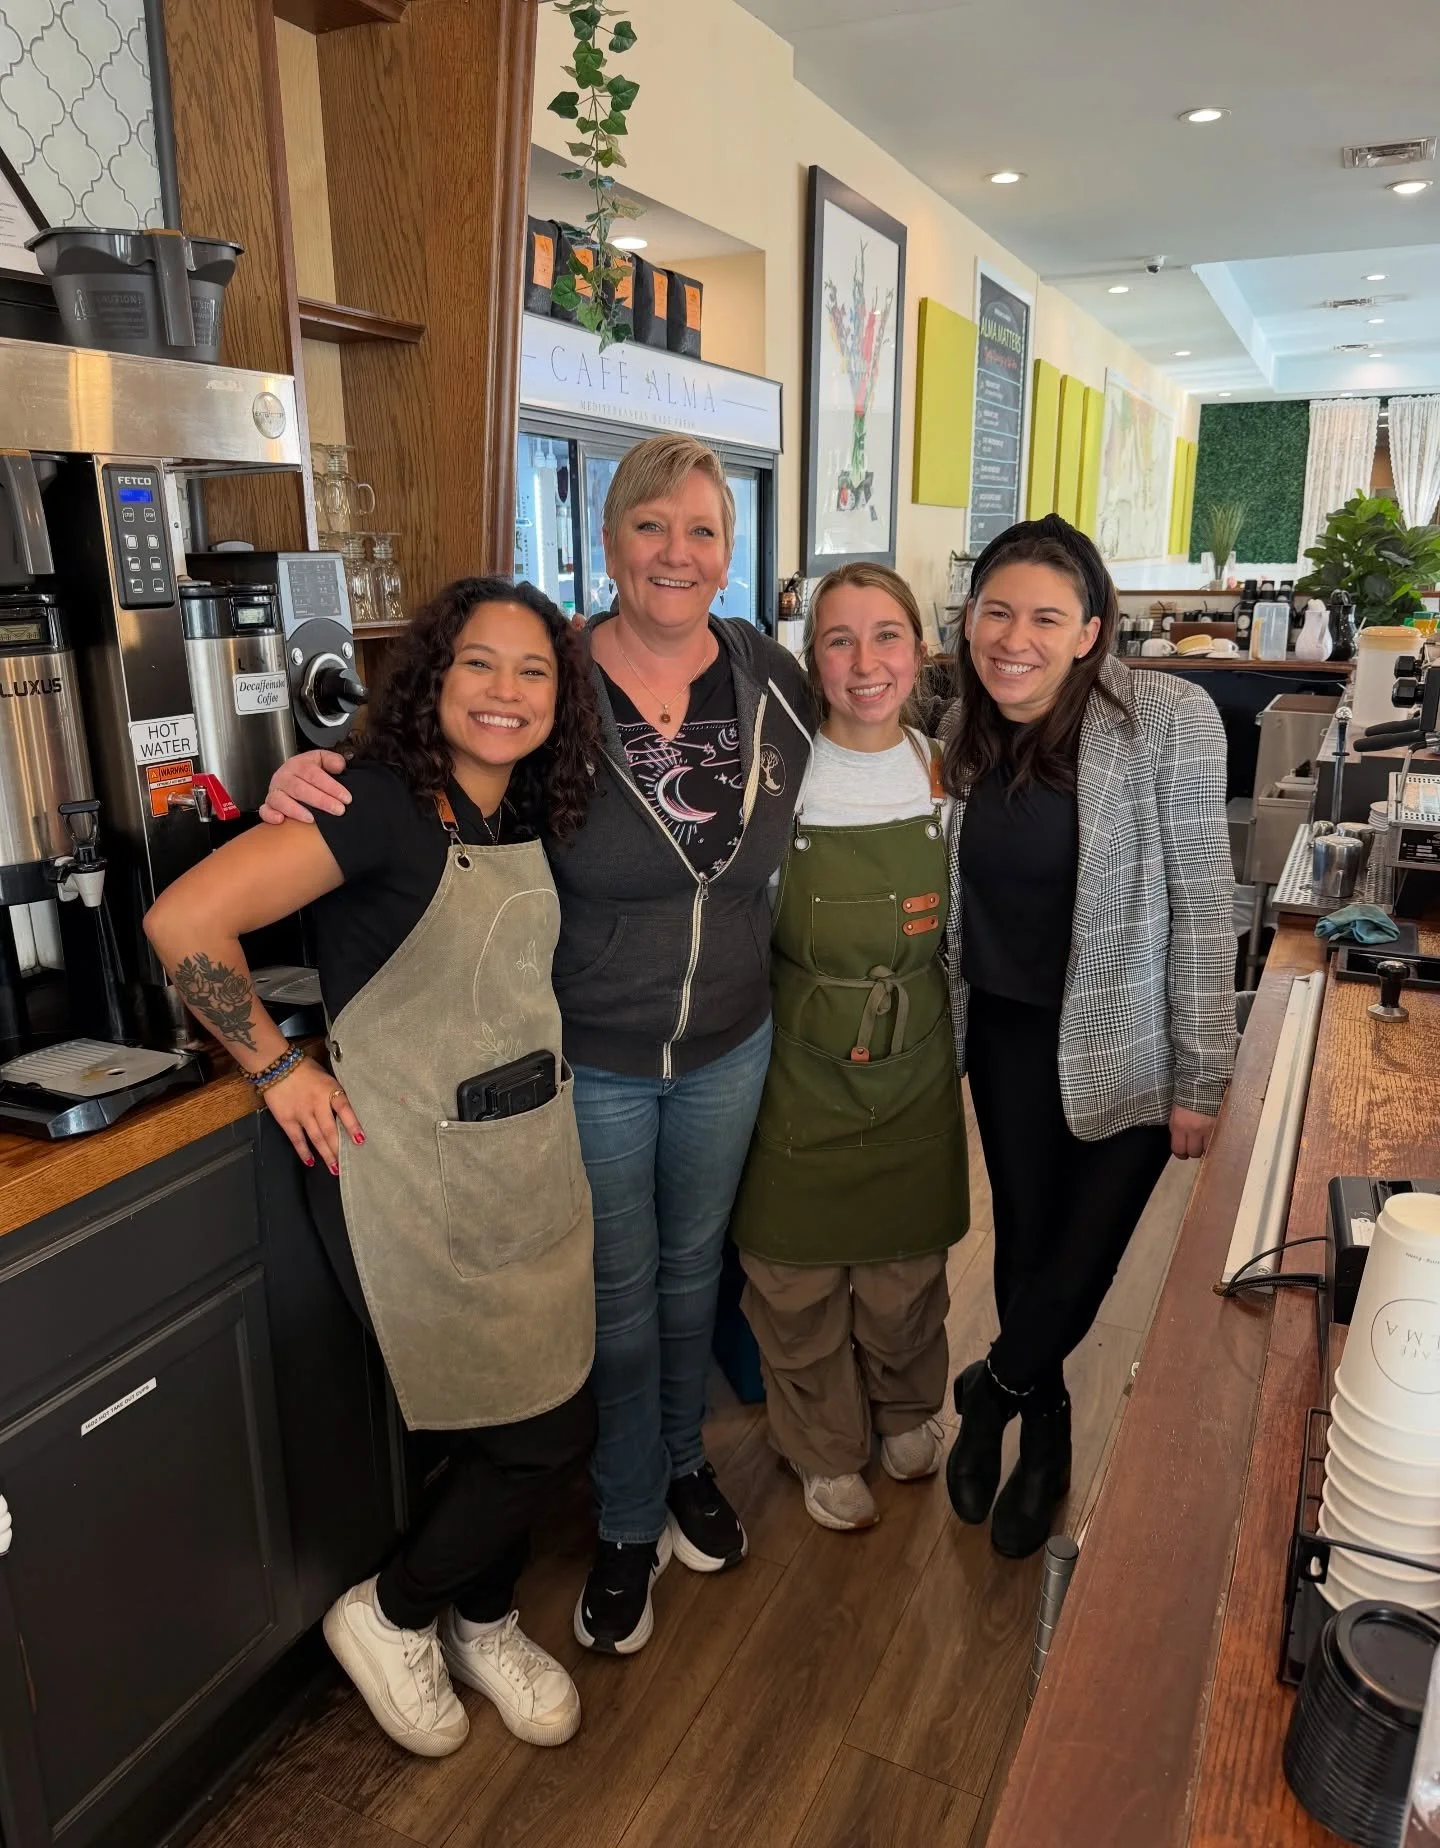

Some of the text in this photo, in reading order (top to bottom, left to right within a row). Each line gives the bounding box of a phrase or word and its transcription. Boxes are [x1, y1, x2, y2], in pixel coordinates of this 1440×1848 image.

[980, 315, 1021, 354] ALMA MATTERS
[550, 345, 716, 413] CAFÉ ALMA
[117, 476, 152, 486] FETCO
[0, 677, 63, 698] LUXUS
[257, 692, 279, 706] Coffee
[147, 722, 180, 740] HOT
[140, 737, 191, 758] WATER
[160, 764, 191, 777] WARNING!
[1386, 1320, 1440, 1349] LMA
[110, 1402, 124, 1413] TAKE
[124, 1394, 135, 1404] OUT
